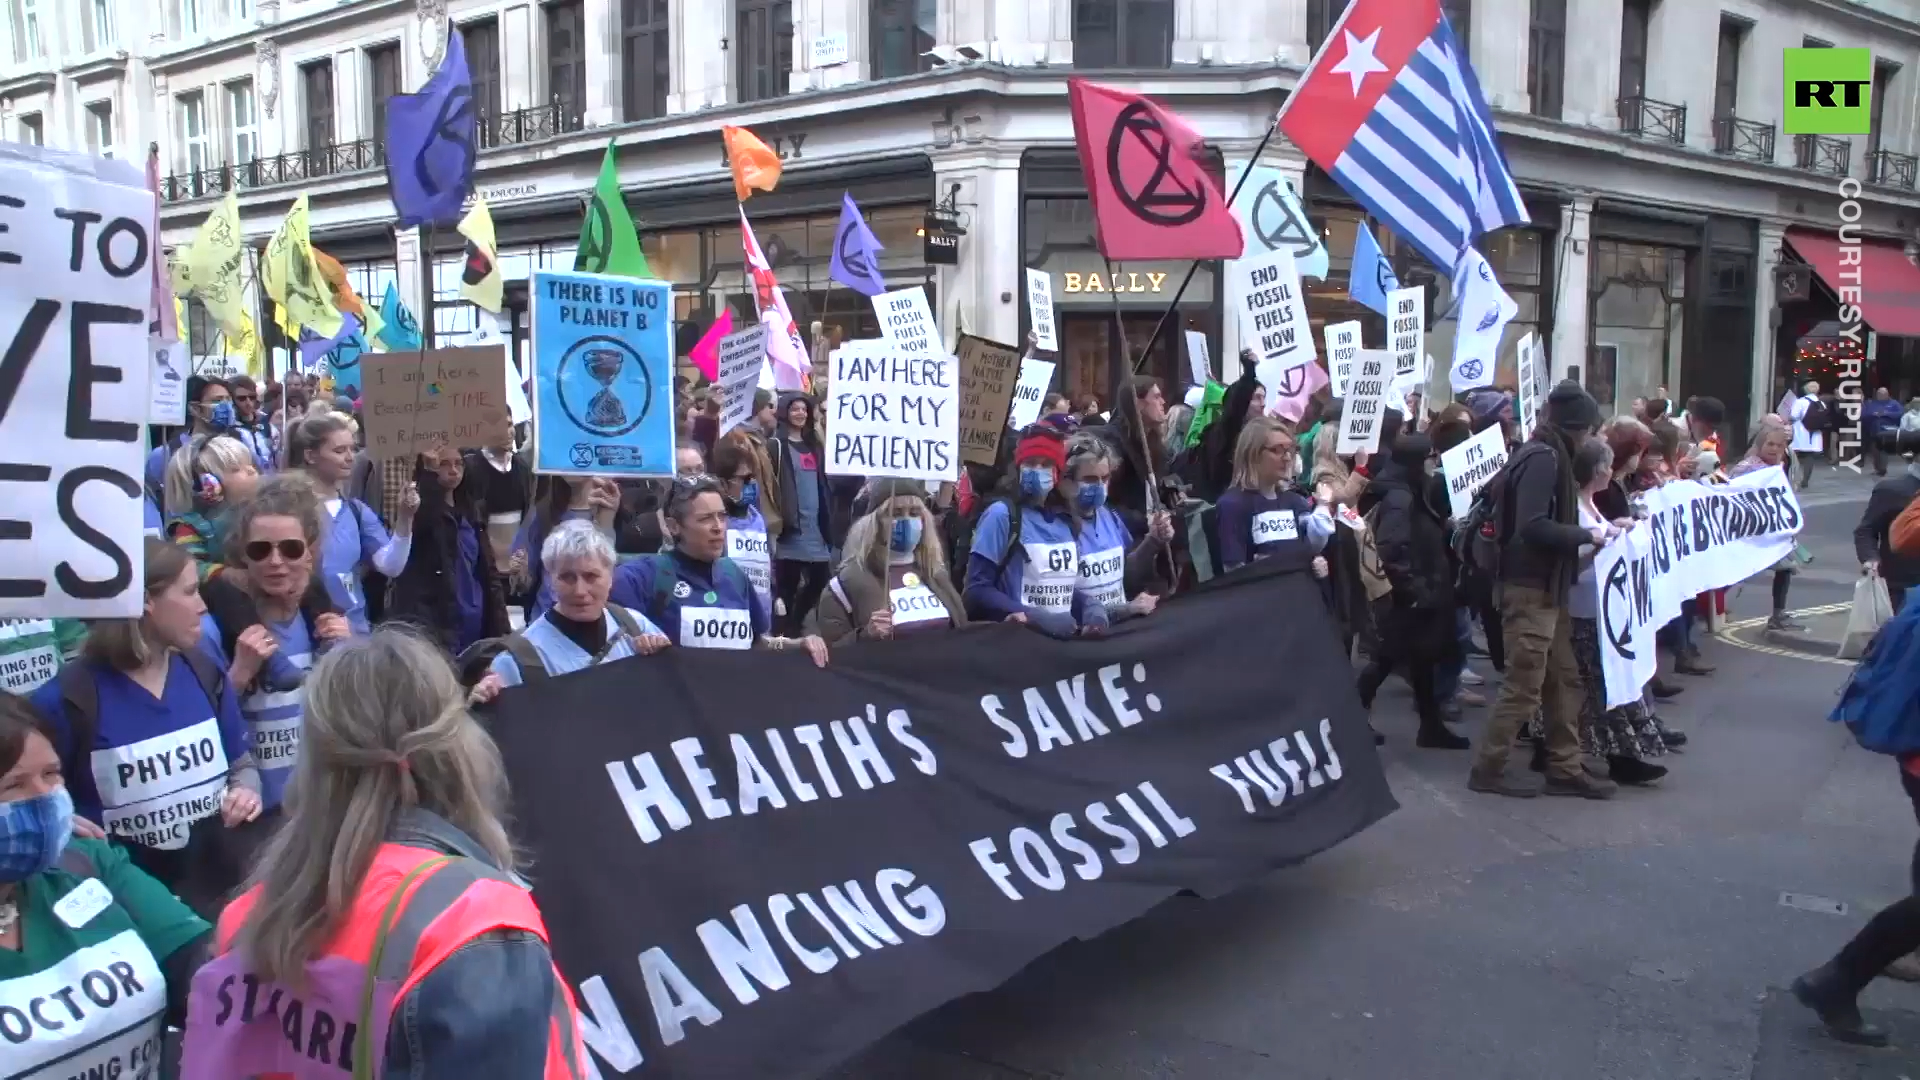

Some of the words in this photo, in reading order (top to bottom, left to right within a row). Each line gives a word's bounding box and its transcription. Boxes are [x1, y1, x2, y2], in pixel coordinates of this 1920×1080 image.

[54, 207, 148, 278] TO
[930, 236, 957, 247] BALLY
[1064, 272, 1167, 293] BALLY
[1250, 265, 1278, 288] END
[547, 280, 603, 303] THERE
[609, 286, 625, 307] IS
[632, 289, 658, 310] NO
[889, 299, 912, 312] END
[1246, 284, 1292, 311] FOSSIL
[1399, 299, 1415, 314] END
[560, 305, 630, 329] PLANET
[636, 311, 648, 330] B
[887, 310, 924, 327] FOSSIL
[1254, 305, 1293, 332] FUELS
[1394, 316, 1420, 334] FOSSIL
[894, 324, 926, 340] FUELS
[1262, 328, 1295, 352] NOW
[1338, 331, 1353, 345] END
[900, 338, 928, 352] NOW
[1395, 334, 1417, 352] FUELS
[1362, 361, 1382, 376] END
[1396, 352, 1416, 370] NOW
[376, 367, 387, 386] I
[437, 359, 480, 381] here
[838, 357, 844, 382] I
[847, 357, 886, 382] AM
[891, 357, 950, 388] HERE
[1352, 380, 1383, 397] FOSSIL
[448, 391, 496, 408] TIME
[836, 392, 891, 422] FOR
[901, 395, 947, 428] MY
[1351, 399, 1378, 414] FUELS
[453, 421, 483, 439] OUT
[1349, 418, 1374, 434] NOW
[834, 433, 950, 472] PATIENTS
[1466, 443, 1484, 466] IT'S
[1451, 453, 1505, 494] HAPPENING
[1672, 503, 1690, 561] BE
[1690, 485, 1799, 552] BYSTANDERS
[1049, 548, 1072, 572] GP
[1028, 595, 1061, 606] PUBLIC
[31, 652, 54, 668] FOR
[6, 667, 52, 688] HEALTH
[116, 737, 215, 789] PHYSIO
[605, 703, 937, 844] HEALTH'S
[980, 662, 1162, 759] SAKE:
[109, 794, 213, 837] PROTESTING
[969, 780, 1197, 901] FOSSIL
[1209, 717, 1342, 814] FUELS
